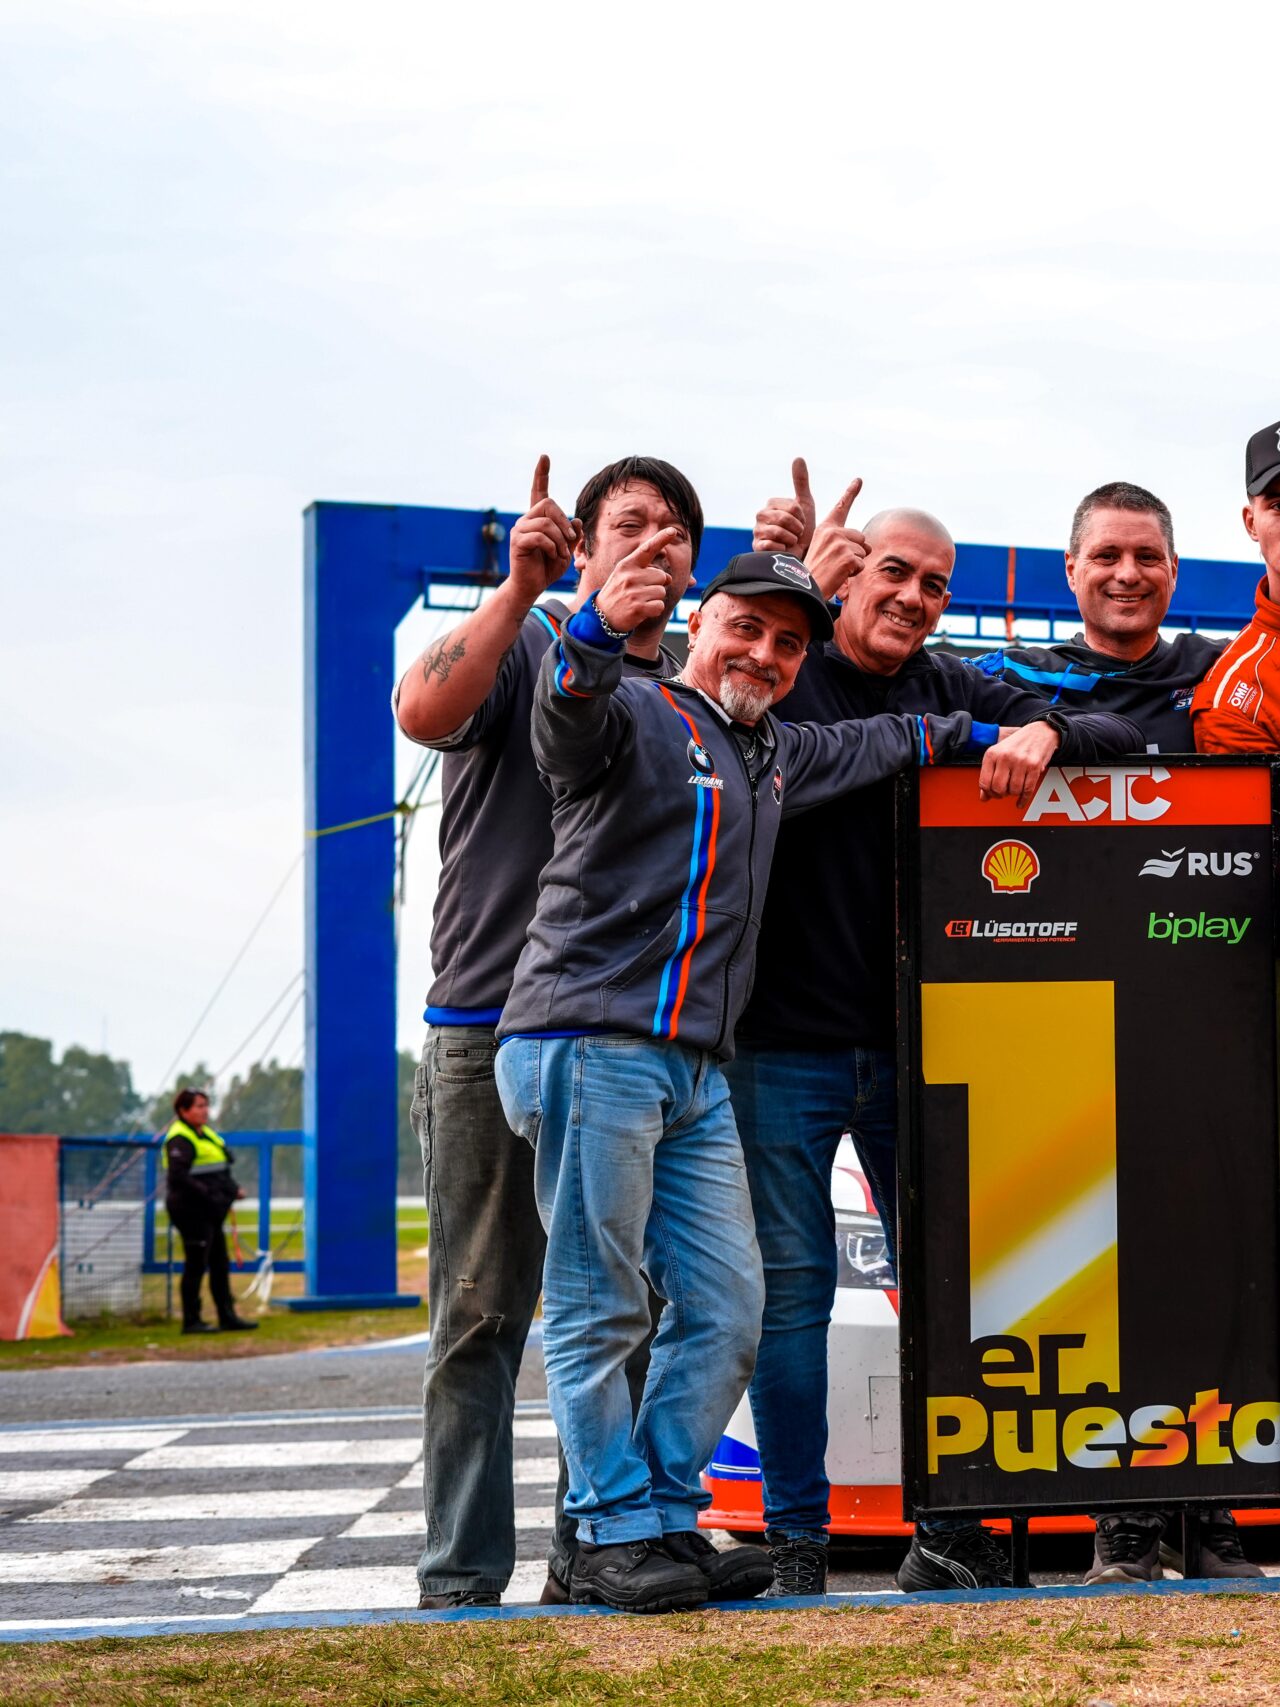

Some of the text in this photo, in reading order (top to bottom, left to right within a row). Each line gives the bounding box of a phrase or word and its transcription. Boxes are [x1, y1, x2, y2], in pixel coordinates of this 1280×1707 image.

[1230, 682, 1249, 707] OMP
[1022, 766, 1172, 821] ACTC
[1147, 911, 1252, 944] bplay
[921, 981, 1120, 1393] 1
